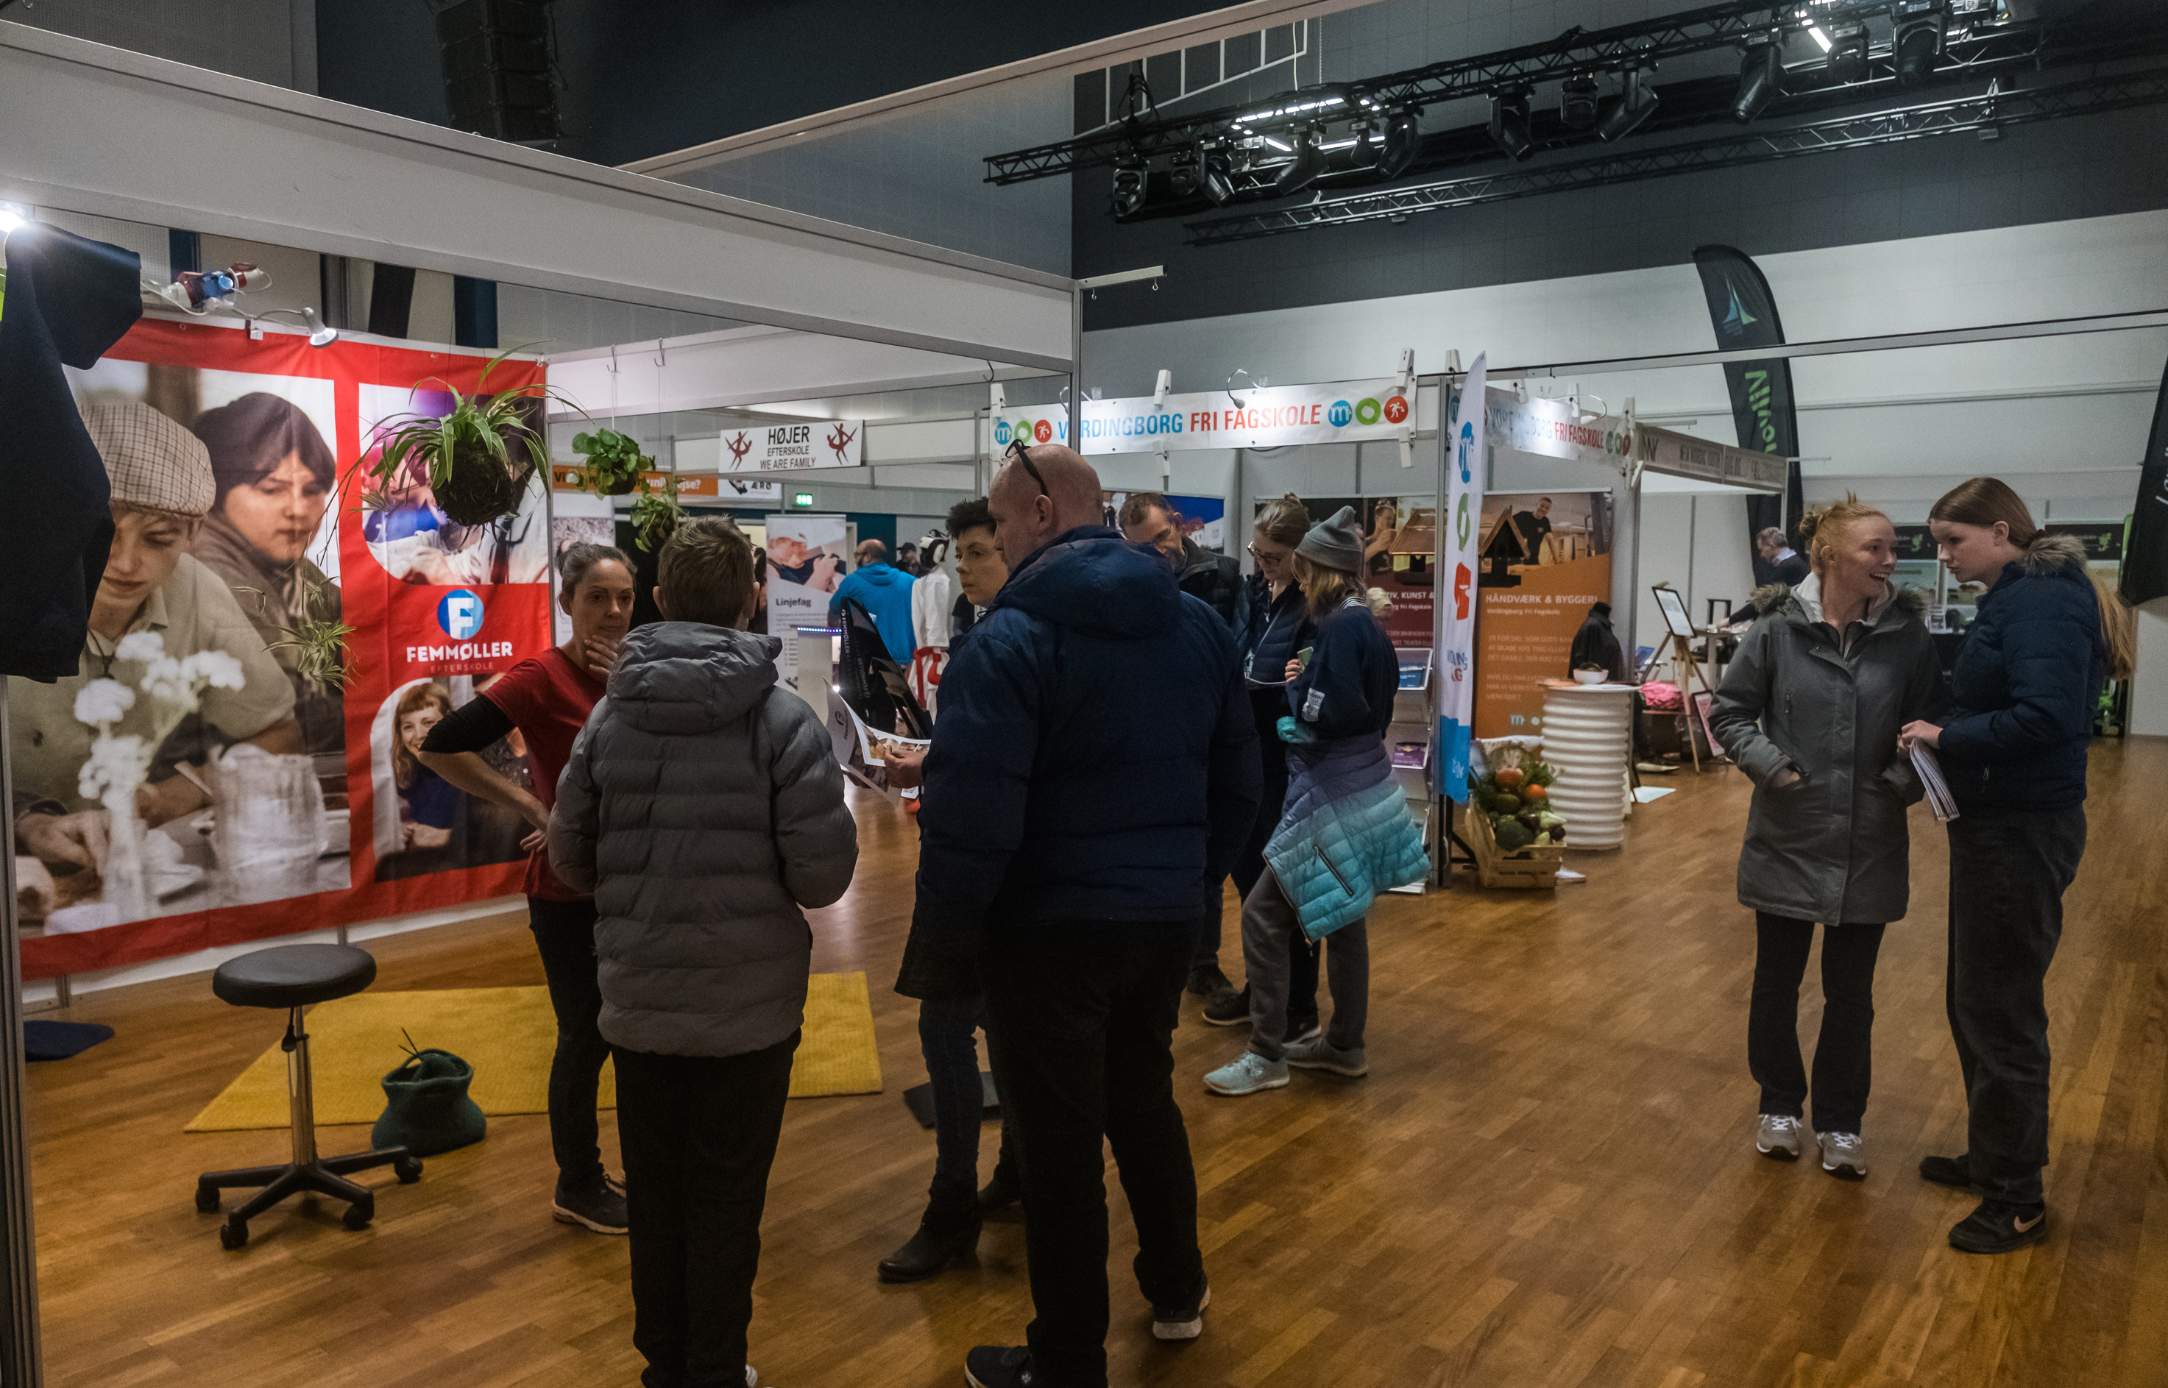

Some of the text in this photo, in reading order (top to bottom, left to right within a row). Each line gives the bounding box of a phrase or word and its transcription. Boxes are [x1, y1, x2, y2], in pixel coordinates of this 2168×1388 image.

[1058, 404, 1322, 440] VRDINGBORG FRI FAGSKOLE
[768, 425, 810, 446] HØJER
[1554, 421, 1567, 442] FRI
[1568, 424, 1604, 450] FAGSKOLE
[767, 445, 810, 458] EFTERSKOLE
[760, 456, 817, 470] WE ARE FAMILY
[775, 597, 812, 608] Linjefag
[1401, 591, 1427, 600] KUNST
[1486, 593, 1542, 604] HÅNDVÆRK
[1544, 595, 1552, 604] &
[406, 641, 513, 663] FEMMØLLER
